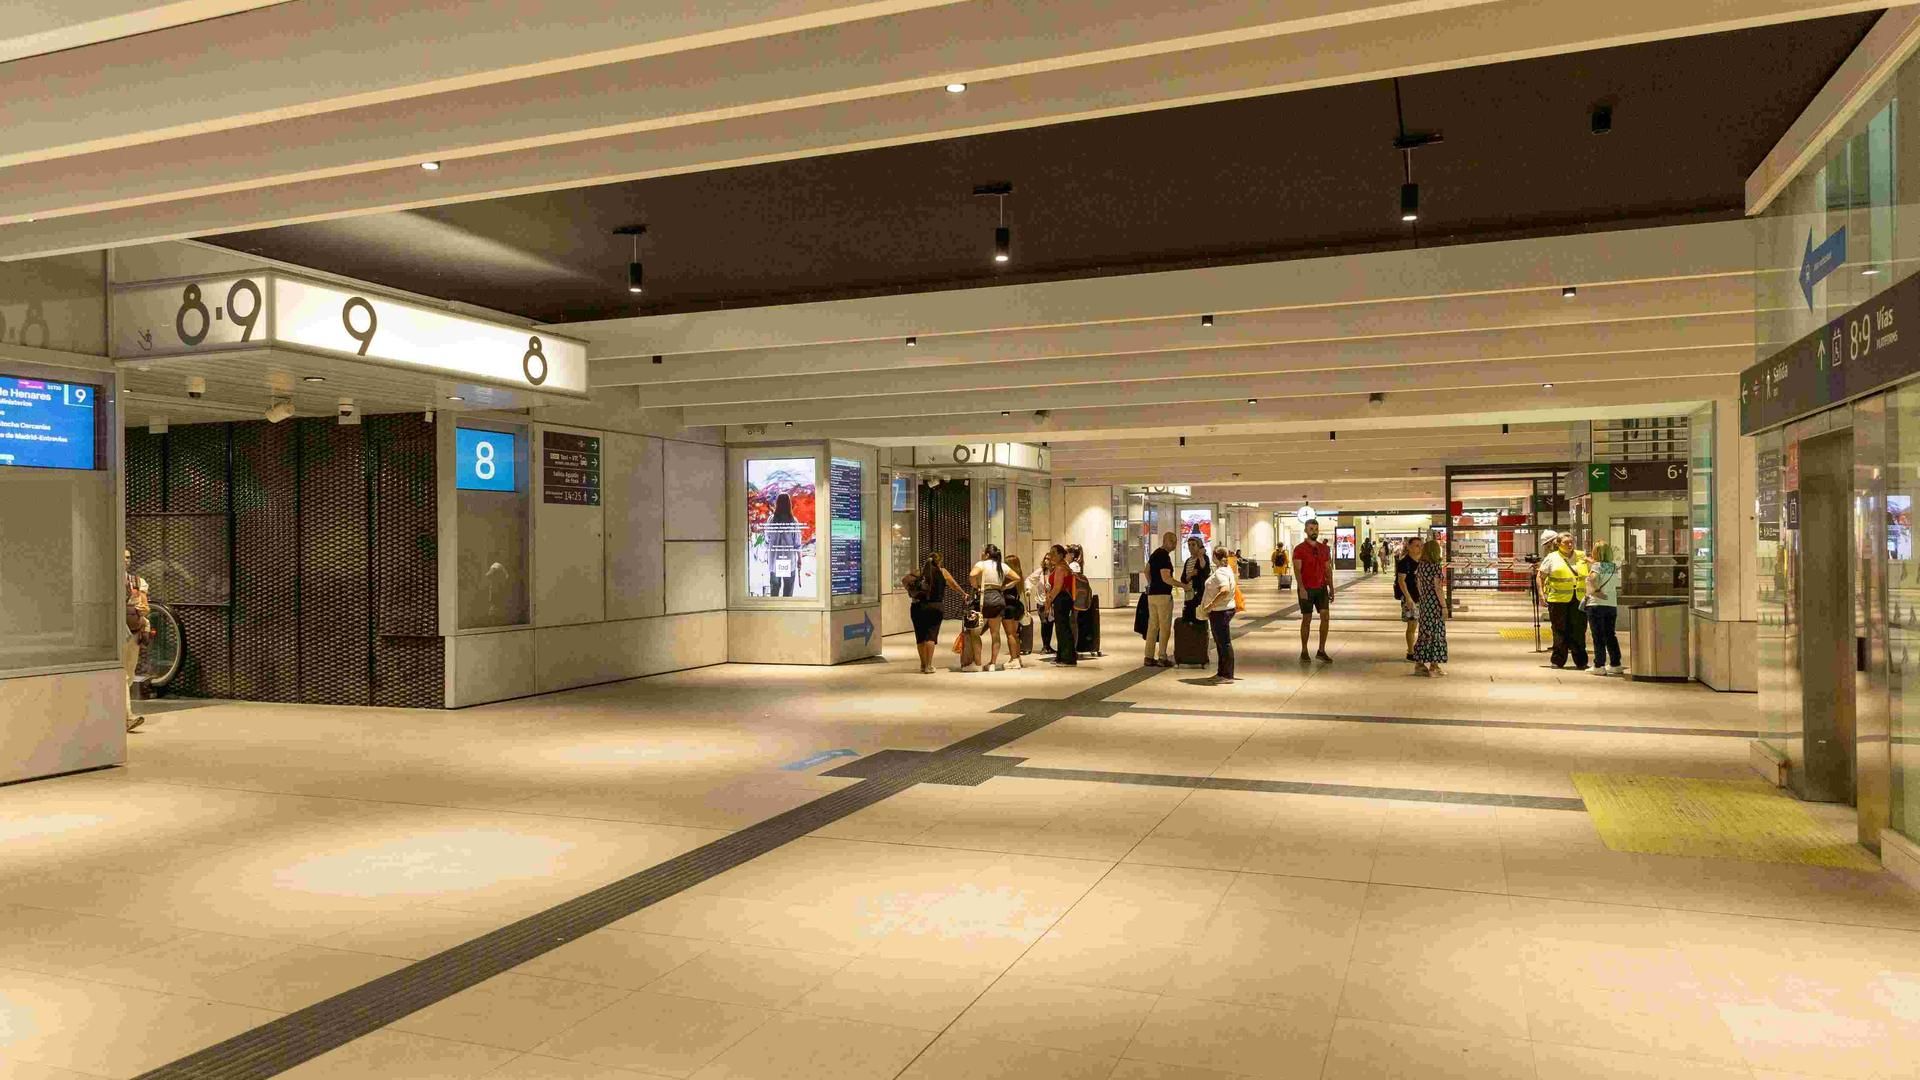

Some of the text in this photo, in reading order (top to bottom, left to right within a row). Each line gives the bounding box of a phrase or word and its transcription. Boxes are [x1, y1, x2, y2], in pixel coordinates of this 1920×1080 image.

[343, 296, 377, 356] 9
[1876, 306, 1893, 331] Vías
[523, 336, 548, 385] 8
[10, 388, 52, 401] Henares
[75, 388, 86, 403] 9
[475, 441, 496, 480] 8
